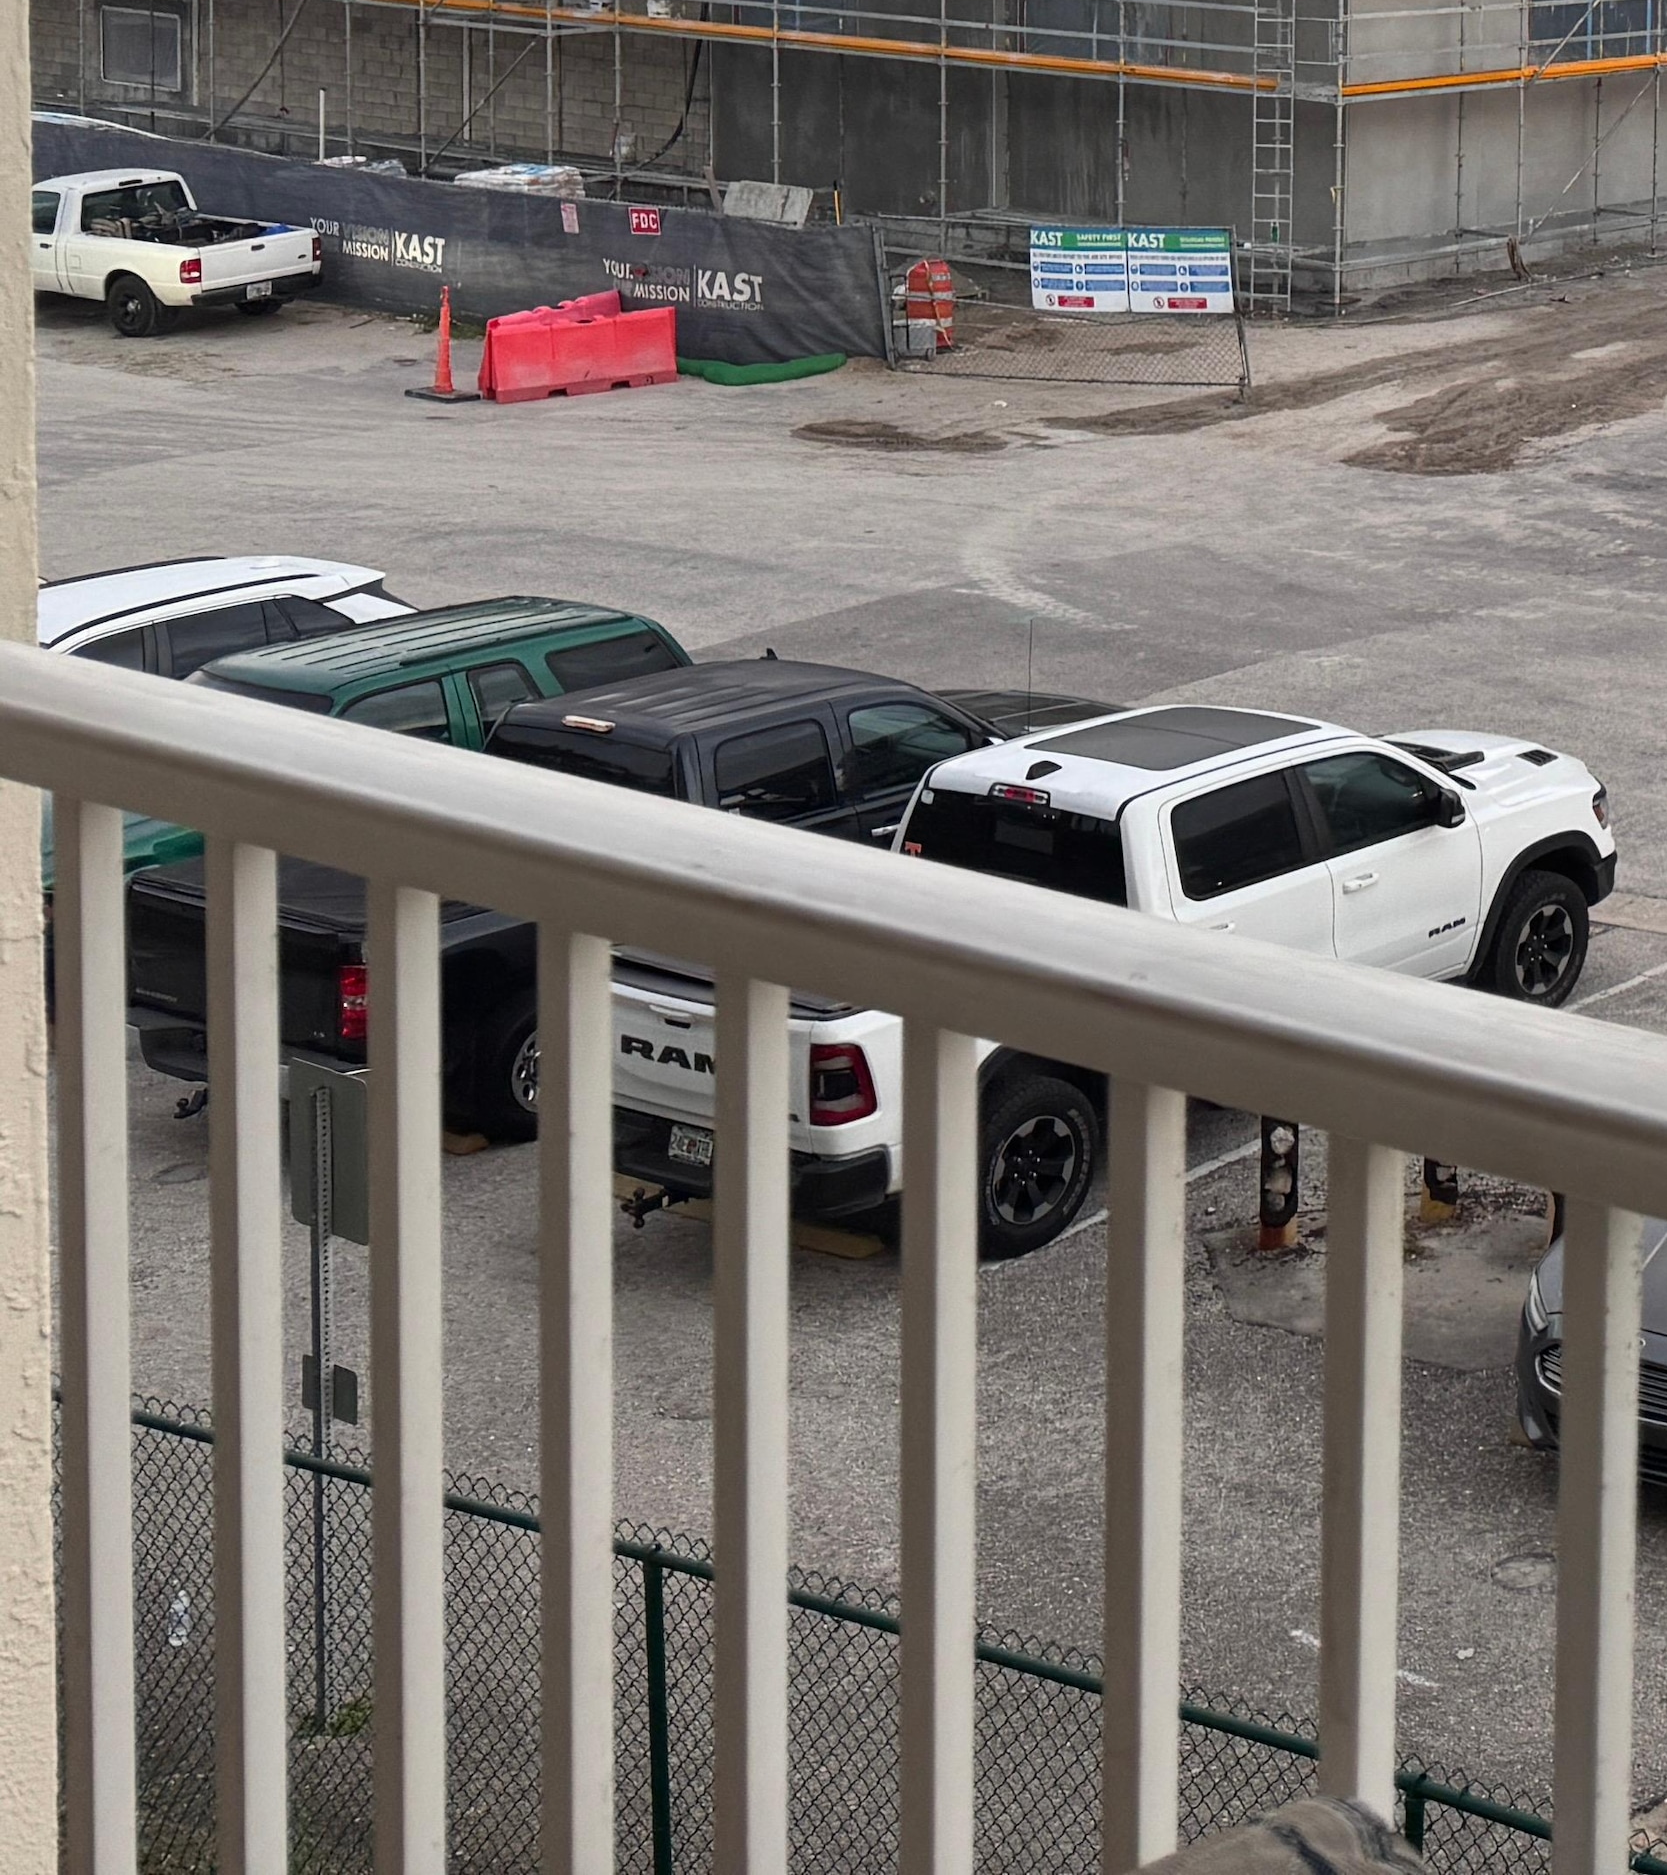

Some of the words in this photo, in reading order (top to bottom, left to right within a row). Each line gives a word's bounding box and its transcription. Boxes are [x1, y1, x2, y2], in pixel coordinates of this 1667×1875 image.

[310, 217, 339, 236] YOUR
[631, 213, 658, 230] FDC
[1029, 230, 1063, 246] KAST
[1127, 233, 1165, 249] KAST
[342, 240, 389, 262] MISSION
[395, 231, 446, 266] KAST
[633, 283, 690, 303] MISSION
[697, 269, 763, 303] KAST
[698, 299, 764, 311] CONSTRUCTION
[1428, 917, 1466, 938] RAM
